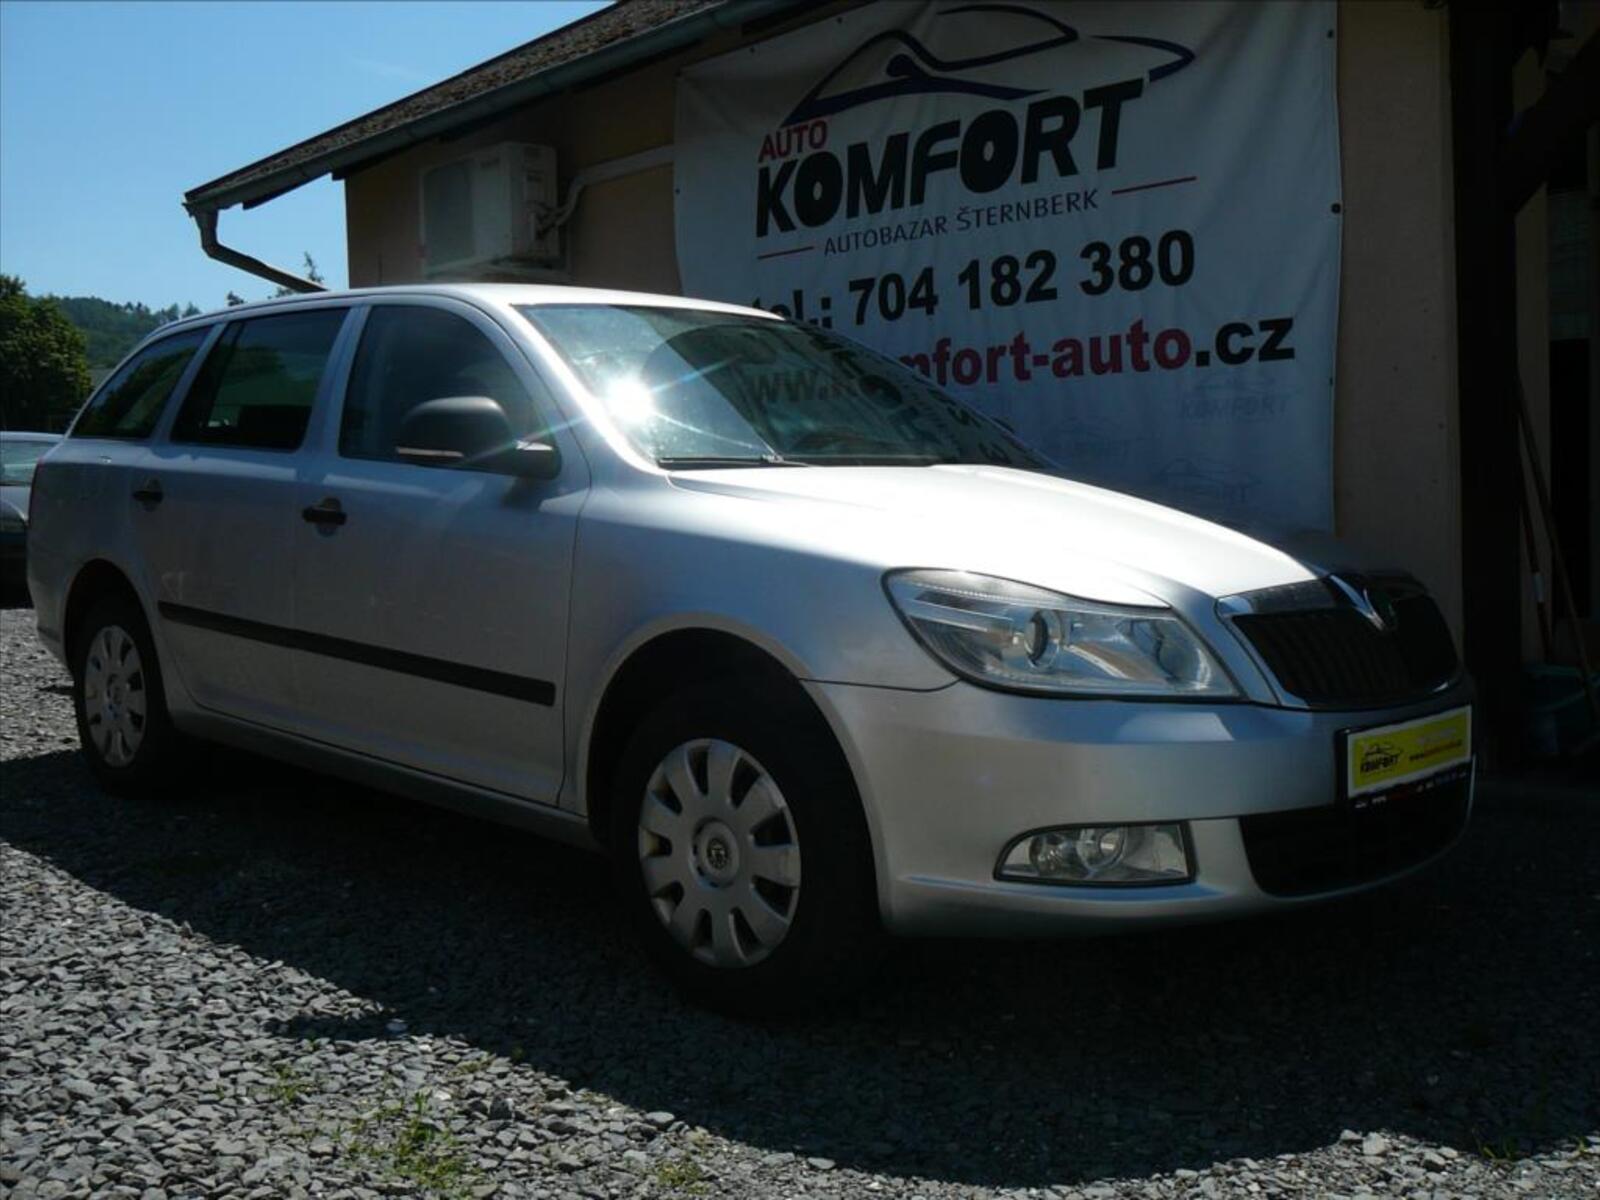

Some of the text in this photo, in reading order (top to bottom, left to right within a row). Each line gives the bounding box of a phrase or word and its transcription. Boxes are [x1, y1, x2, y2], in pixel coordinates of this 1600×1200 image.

[756, 78, 1144, 237] KOMFORT
[757, 120, 828, 163] AUTO
[823, 189, 1099, 257] AUTOBAZAR ŠTERNBERK
[849, 267, 939, 325] 704
[958, 250, 1058, 309] 182
[1080, 230, 1195, 295] 380
